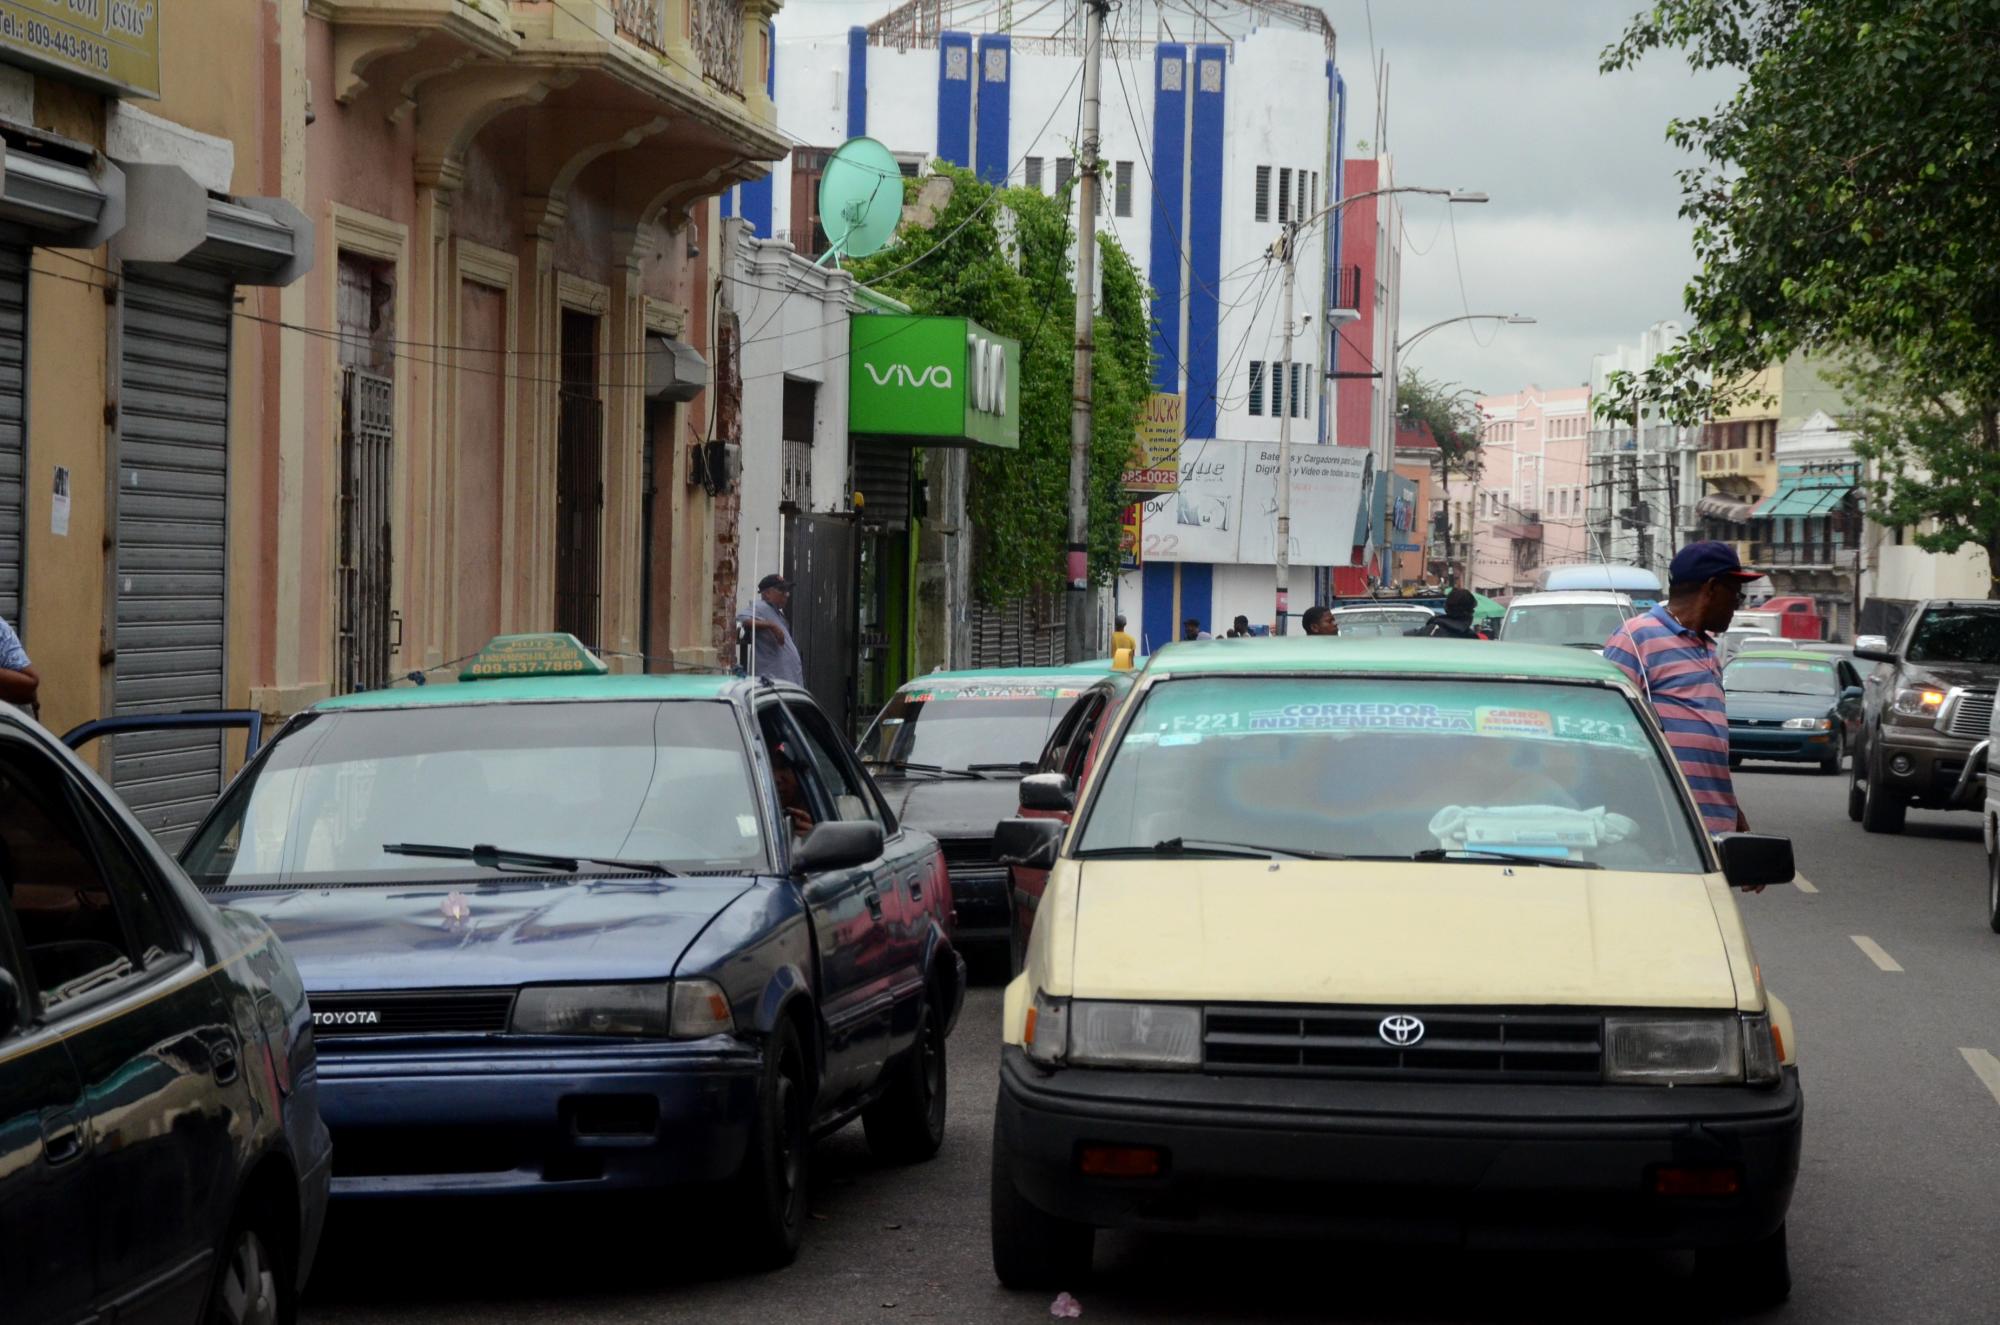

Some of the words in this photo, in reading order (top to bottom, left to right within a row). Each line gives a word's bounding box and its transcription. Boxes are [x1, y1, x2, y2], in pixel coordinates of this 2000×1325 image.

[27, 20, 109, 69] 809-443-8113
[1156, 427, 1176, 435] mejor
[1283, 703, 1437, 717] CORREDOR
[1489, 709, 1538, 719] CARRO
[1173, 712, 1239, 730] F-221
[1251, 714, 1471, 730] INDEPENDENCIA
[312, 1011, 378, 1024] TOYOTA
